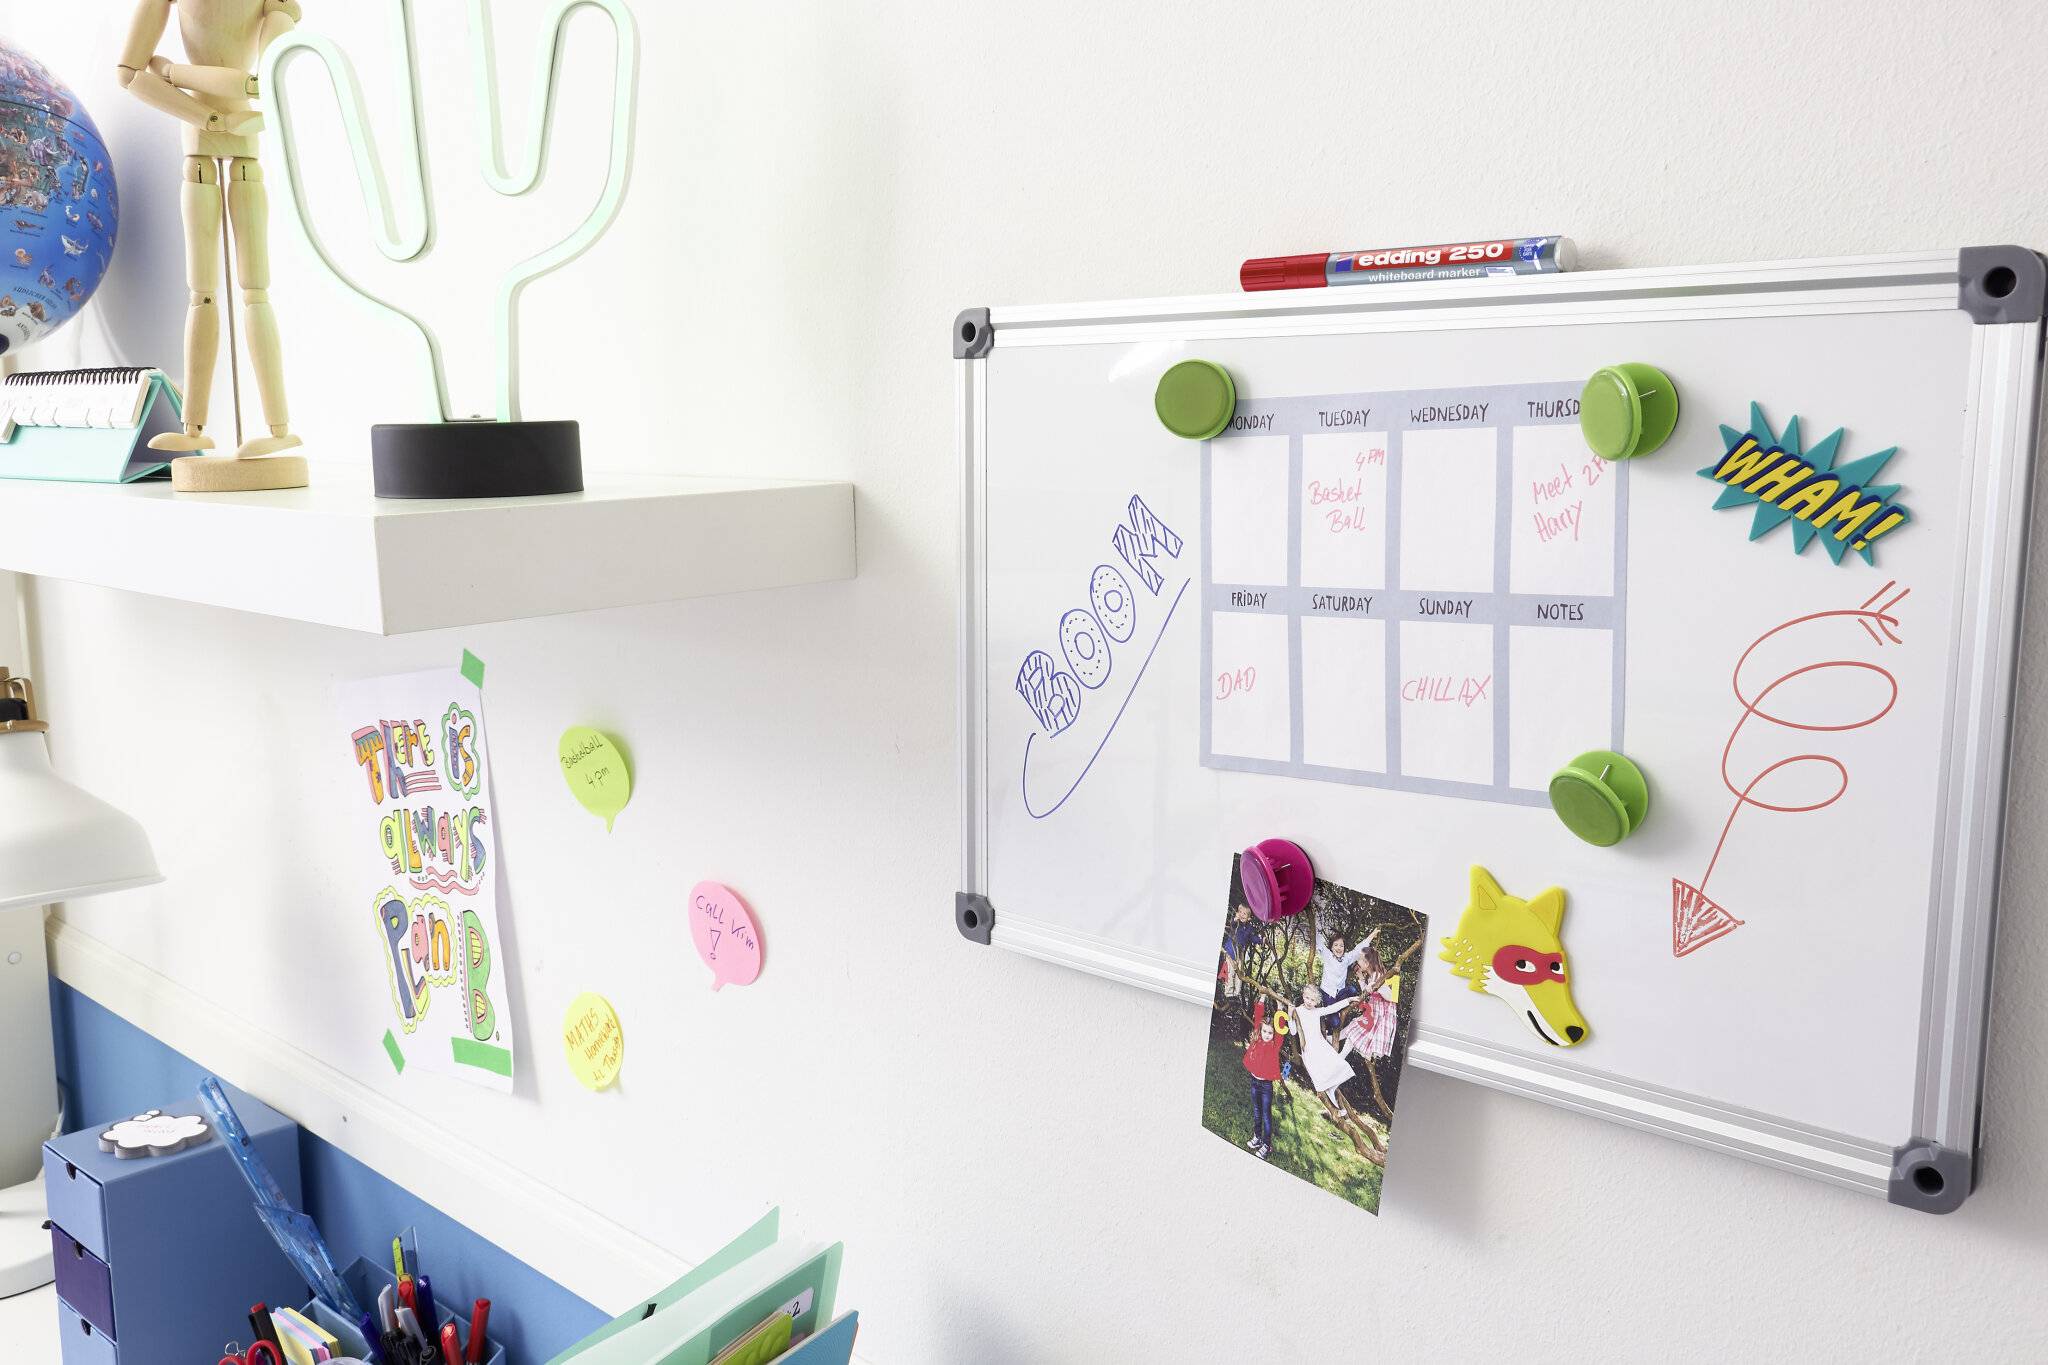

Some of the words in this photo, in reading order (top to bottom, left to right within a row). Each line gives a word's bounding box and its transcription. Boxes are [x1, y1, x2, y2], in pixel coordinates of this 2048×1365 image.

[1358, 249, 1441, 267] edding
[1448, 243, 1504, 261] 250
[1368, 268, 1434, 282] whiteboard
[1438, 267, 1481, 279] marker
[1318, 408, 1371, 427] TUESDAY
[1410, 403, 1489, 423] WEDNESDAY
[1527, 398, 1581, 418] THURSD
[1308, 477, 1363, 505] Basket
[1531, 463, 1573, 505] Meet
[1711, 432, 1906, 551] WHAM!
[1326, 506, 1366, 533] Ball
[1533, 500, 1583, 543] Harry
[1016, 494, 1184, 738] BOOM
[1311, 593, 1373, 615] SATURDAY
[1418, 597, 1473, 619] SUNDAY
[1536, 603, 1585, 621] NOTES
[1215, 666, 1257, 701] DAD
[565, 1006, 600, 1052] MATHS
[1273, 1010, 1291, 1036] C
